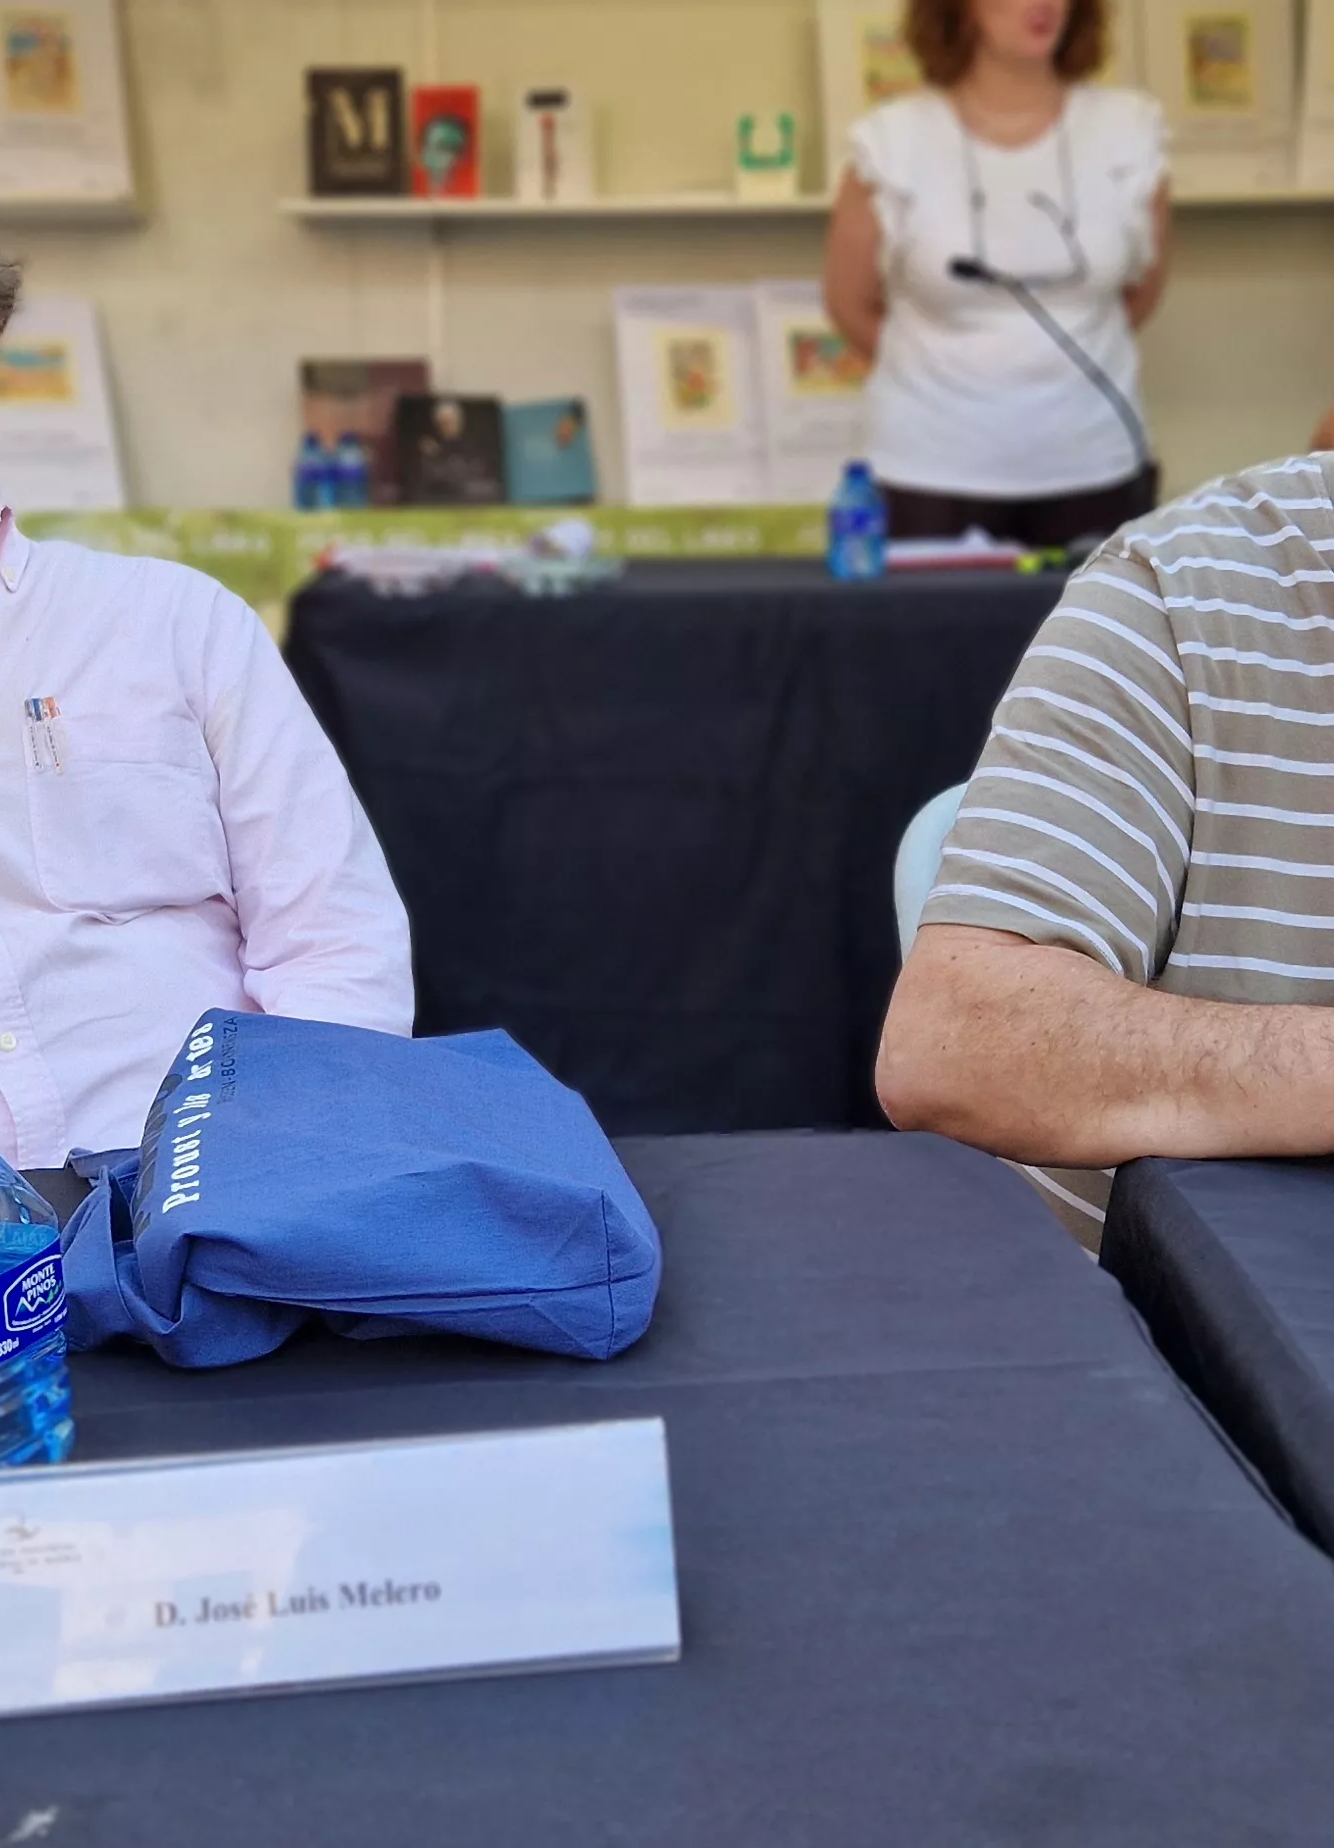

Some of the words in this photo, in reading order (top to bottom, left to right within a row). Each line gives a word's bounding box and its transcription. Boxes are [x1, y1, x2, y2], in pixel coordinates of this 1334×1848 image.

[162, 1130, 201, 1214] Proust
[21, 1262, 55, 1293] MONTE
[26, 1275, 57, 1302] PINOS
[154, 1600, 186, 1628] D.
[194, 1594, 257, 1623] José
[266, 1585, 330, 1617] Luis
[338, 1579, 443, 1609] Melero
